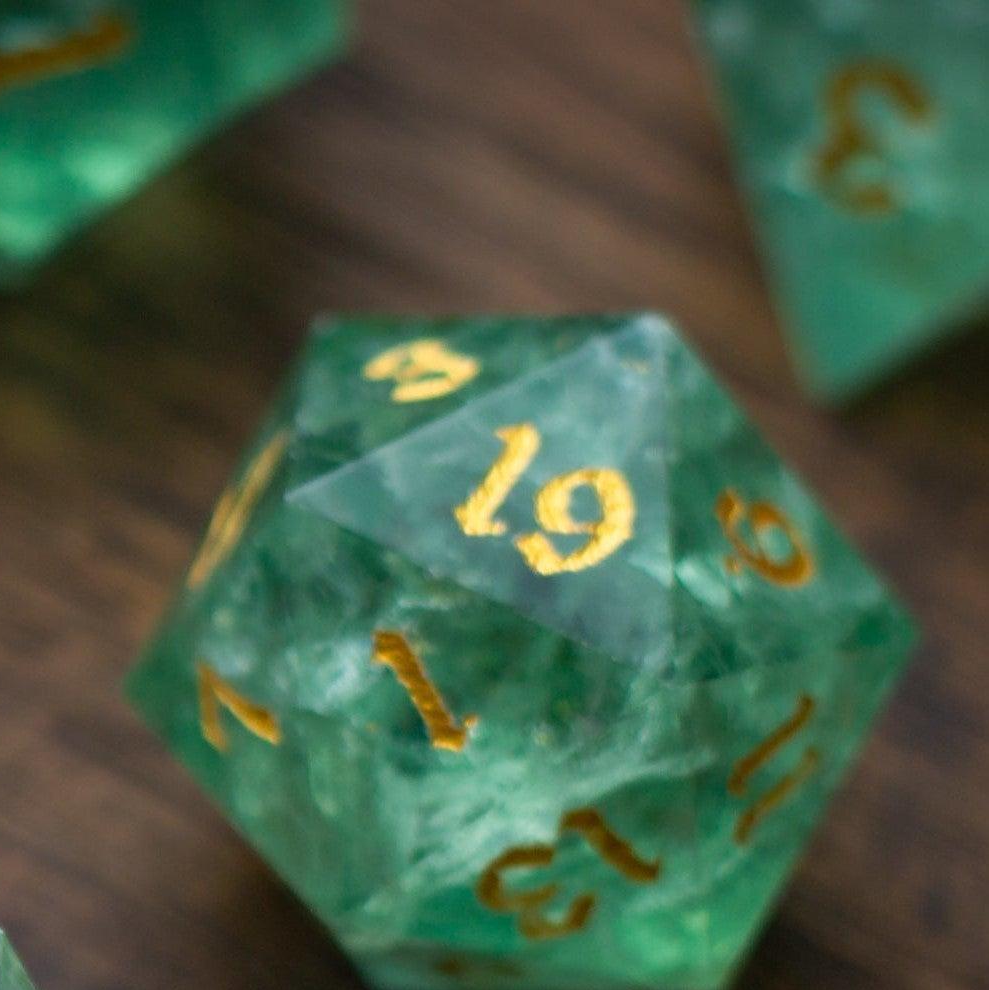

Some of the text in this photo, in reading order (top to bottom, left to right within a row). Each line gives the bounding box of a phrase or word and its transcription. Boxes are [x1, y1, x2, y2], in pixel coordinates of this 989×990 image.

[453, 424, 635, 575] 19
[374, 630, 479, 752] 1
[476, 808, 662, 940] 13
